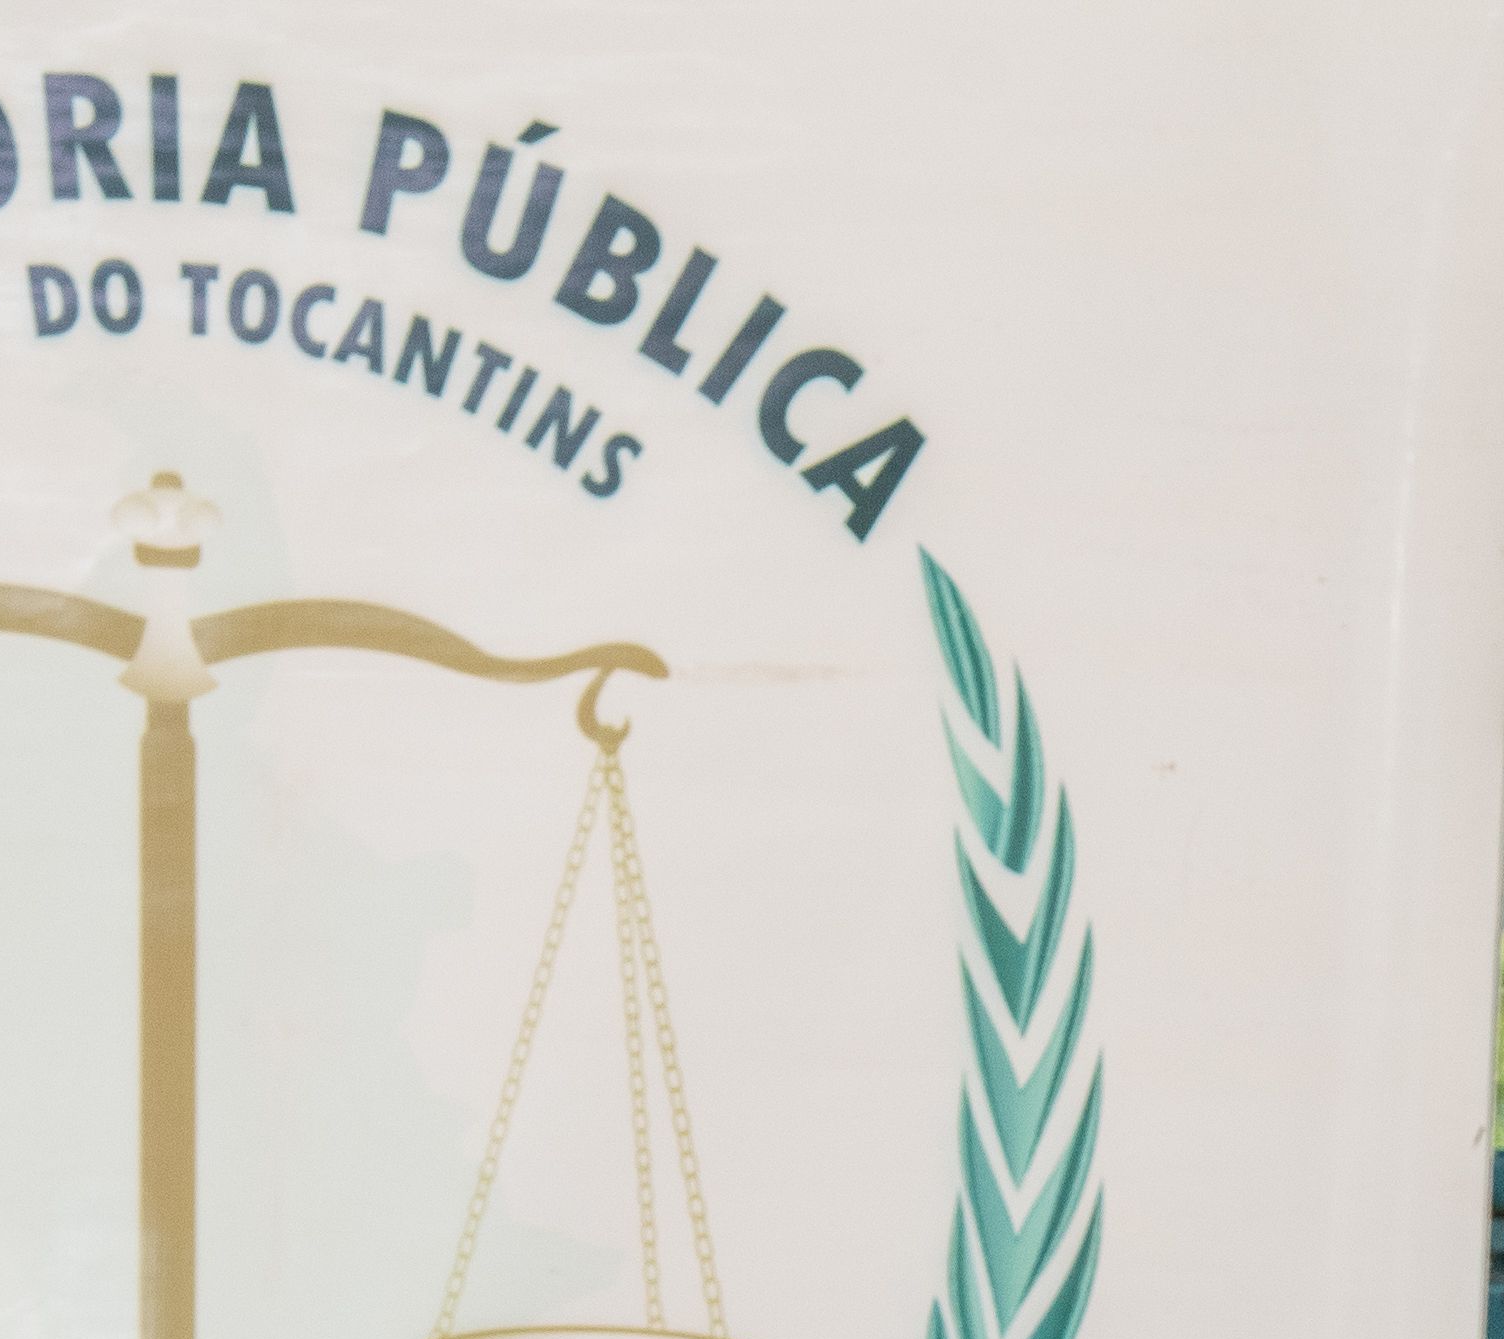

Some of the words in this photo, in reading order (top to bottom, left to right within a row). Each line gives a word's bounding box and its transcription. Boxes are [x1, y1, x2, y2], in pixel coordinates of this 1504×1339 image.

[28, 259, 143, 337] DO
[180, 262, 644, 500] TOCANTINS
[360, 109, 926, 543] PÚBLICA
